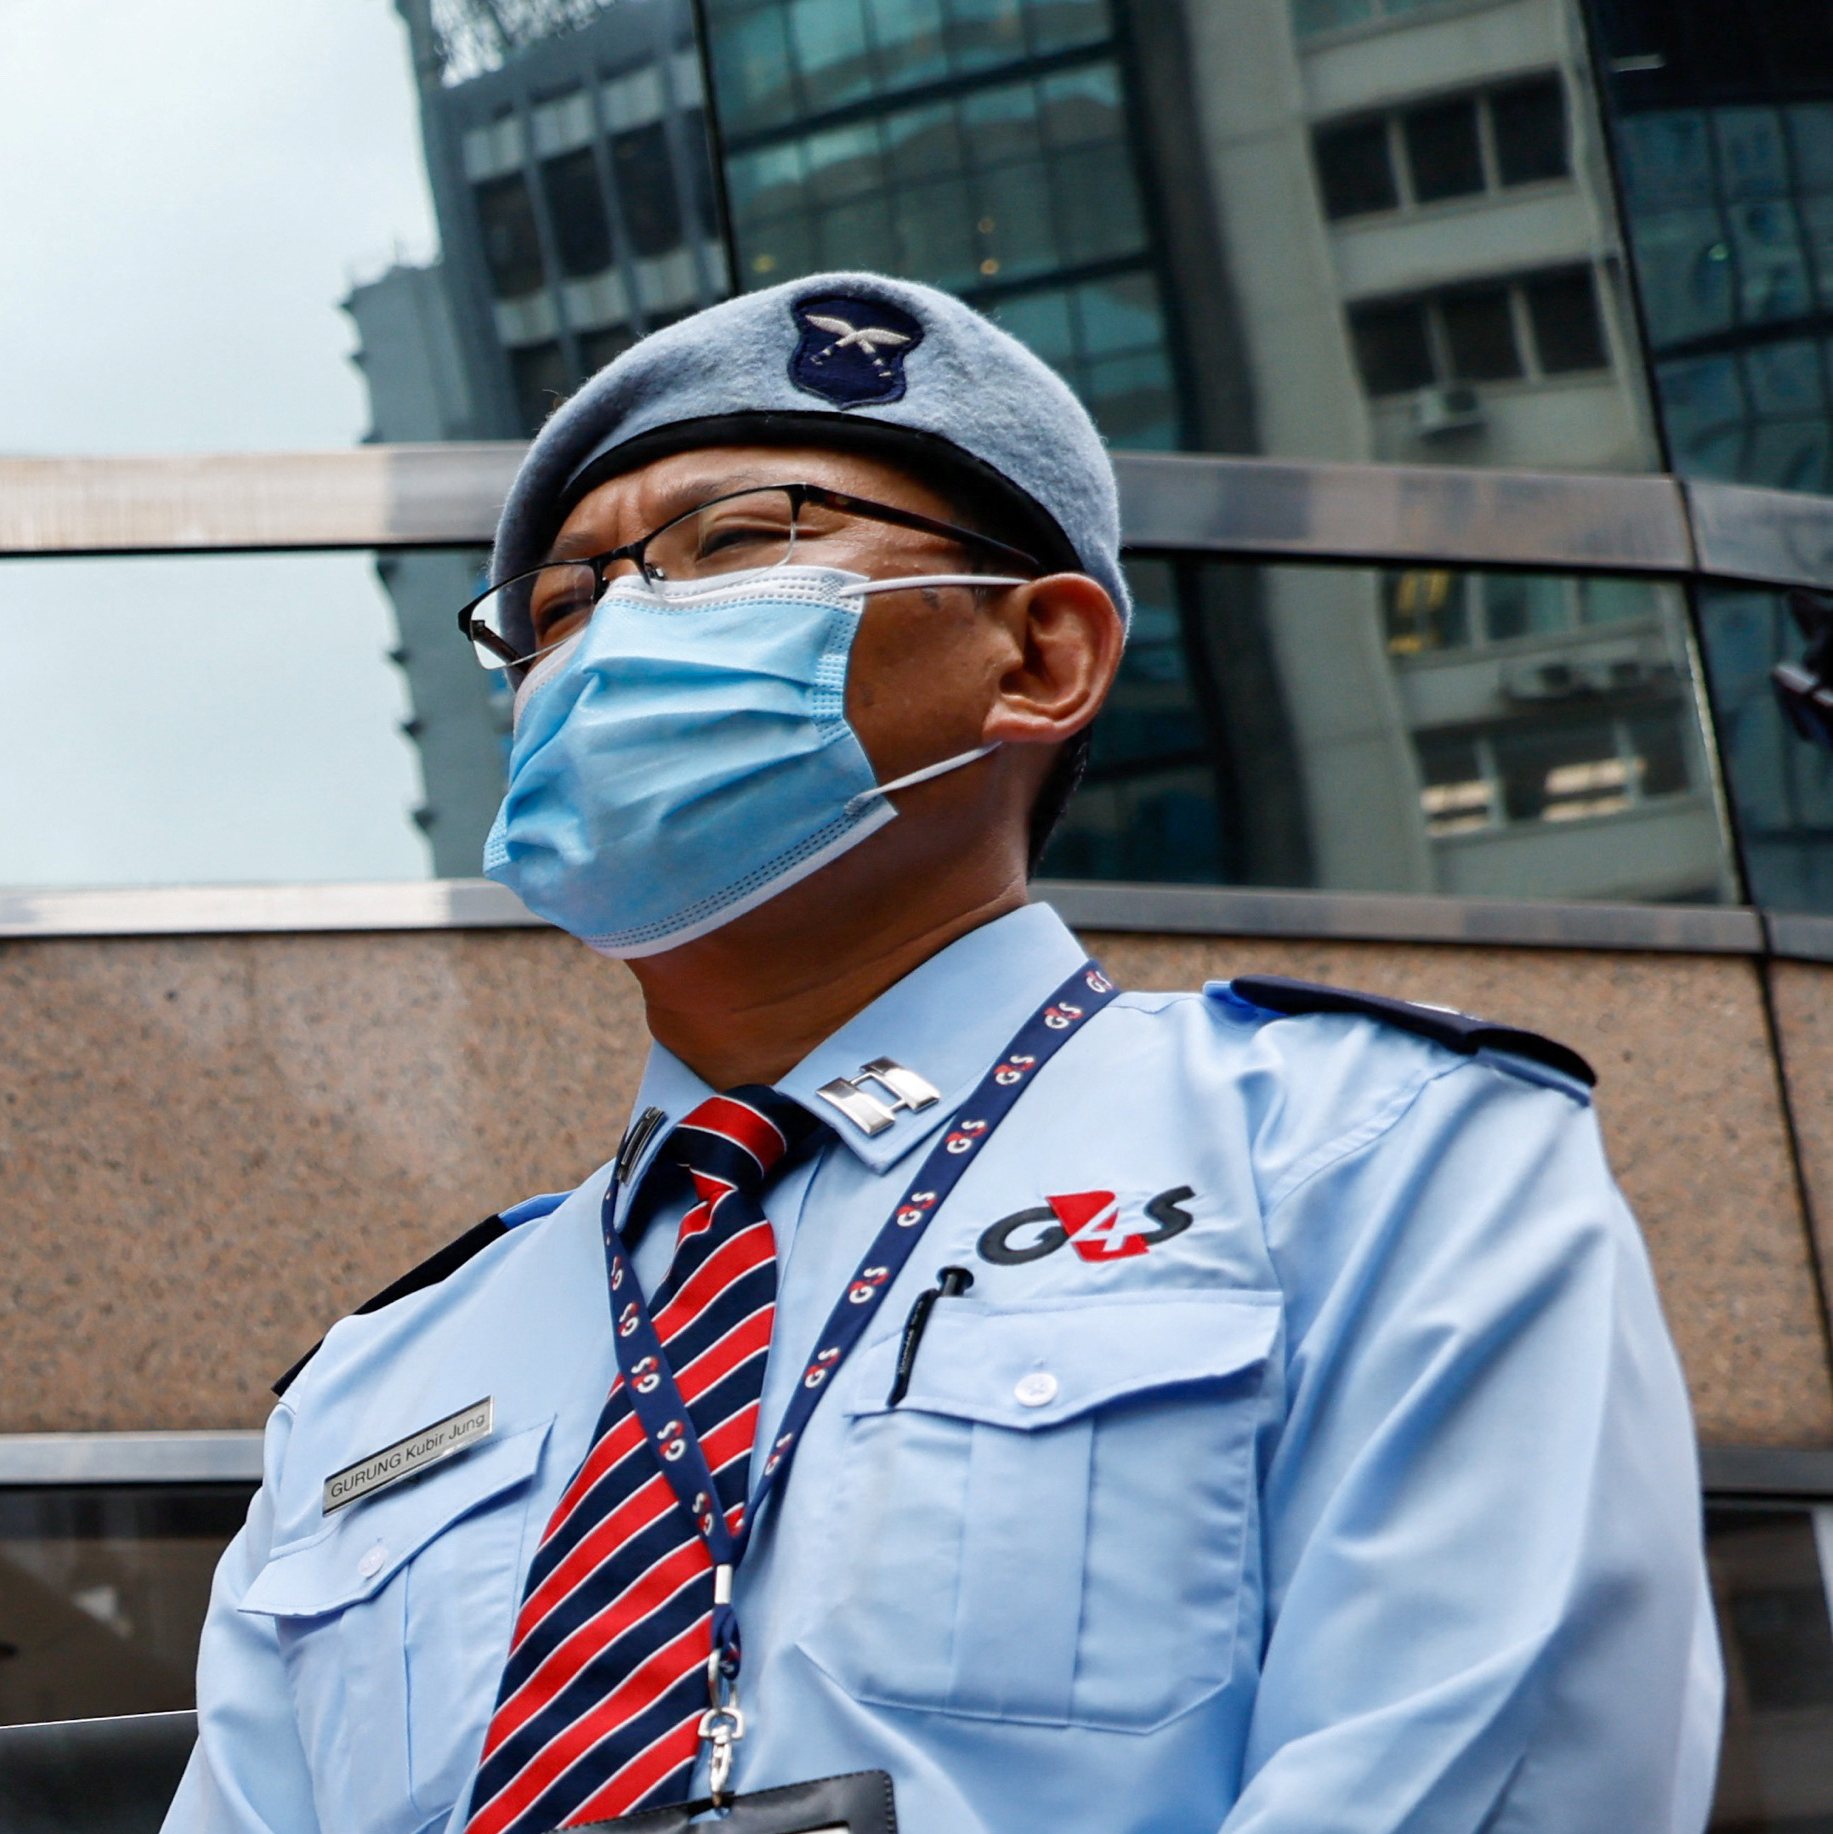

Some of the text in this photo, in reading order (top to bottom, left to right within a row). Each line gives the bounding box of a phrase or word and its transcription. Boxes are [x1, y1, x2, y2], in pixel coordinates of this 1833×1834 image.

[976, 1185, 1196, 1266] G4S
[330, 1412, 486, 1498] GURUNG Kubir Jung
